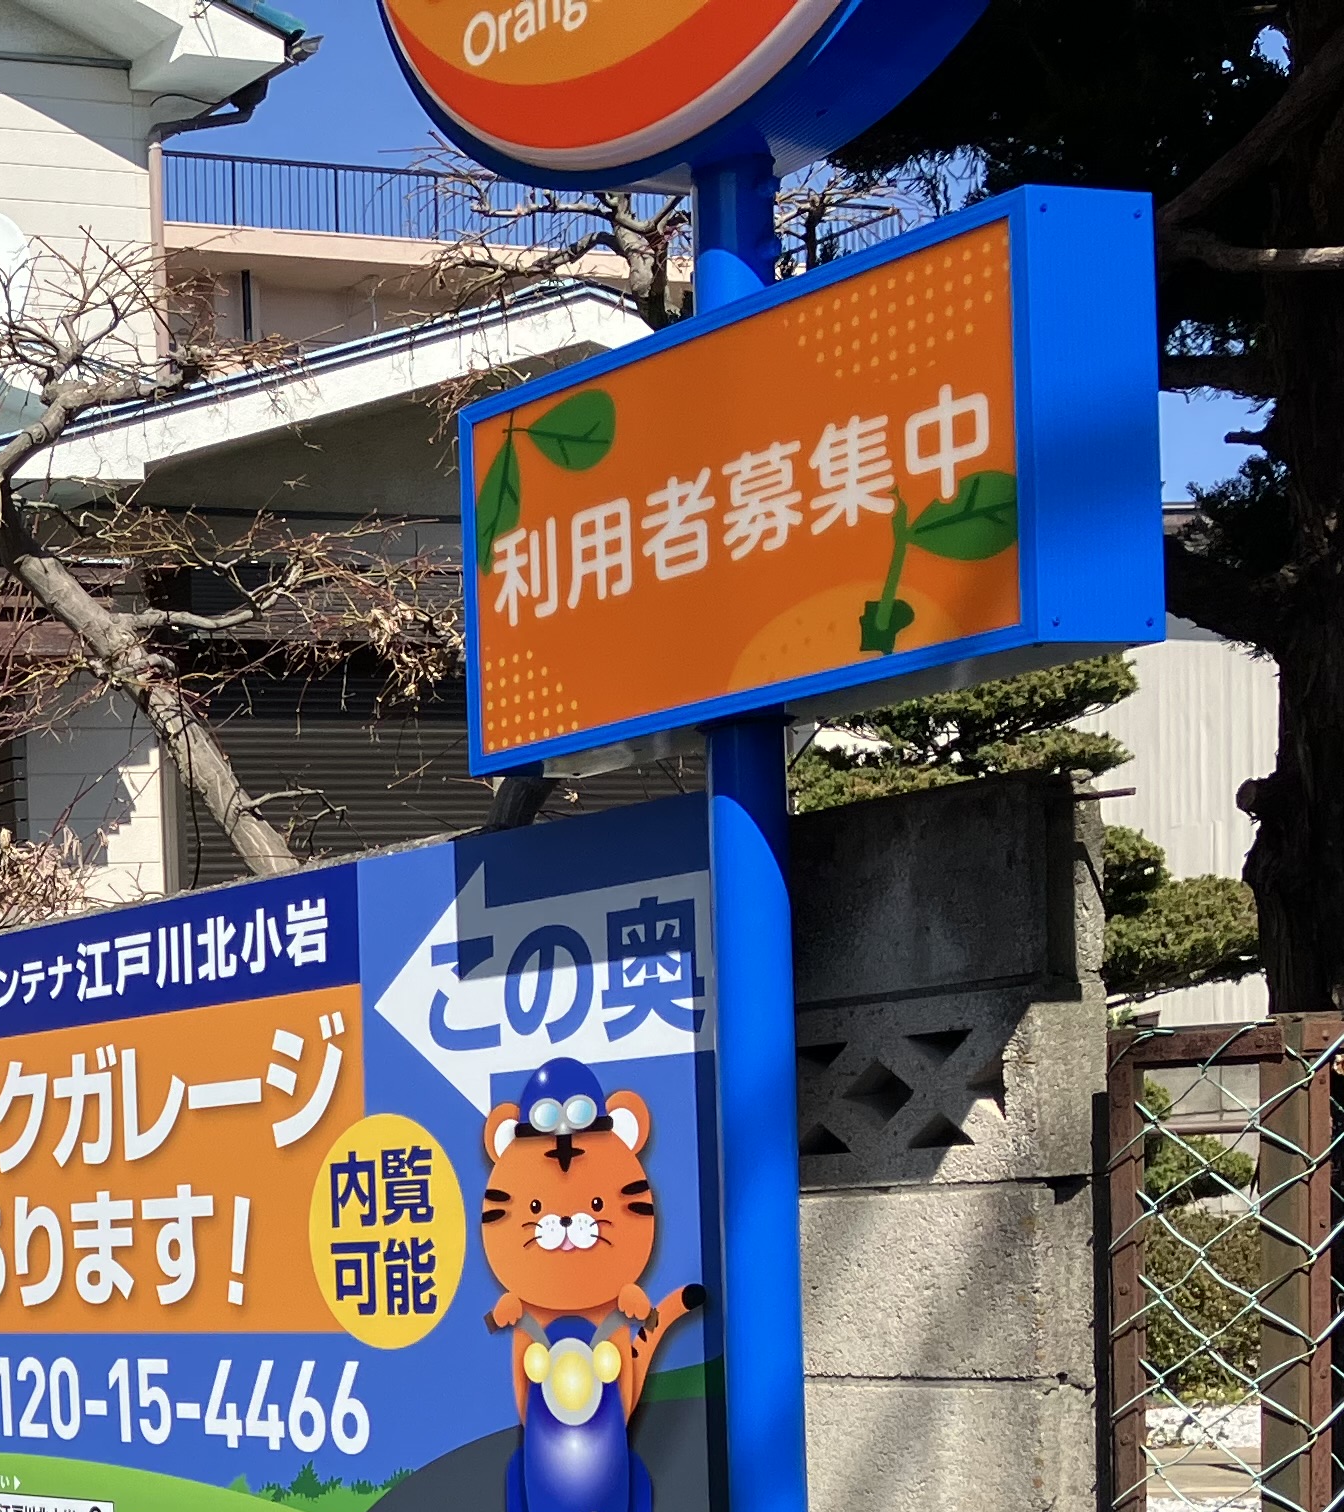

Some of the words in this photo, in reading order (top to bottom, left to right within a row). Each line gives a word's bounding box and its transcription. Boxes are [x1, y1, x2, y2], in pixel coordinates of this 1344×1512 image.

[464, 0, 603, 66] Orang
[493, 384, 990, 627] 利用者募集中
[428, 895, 705, 1052] この奥
[328, 1146, 435, 1228] 内覧
[332, 1236, 439, 1316] 可能
